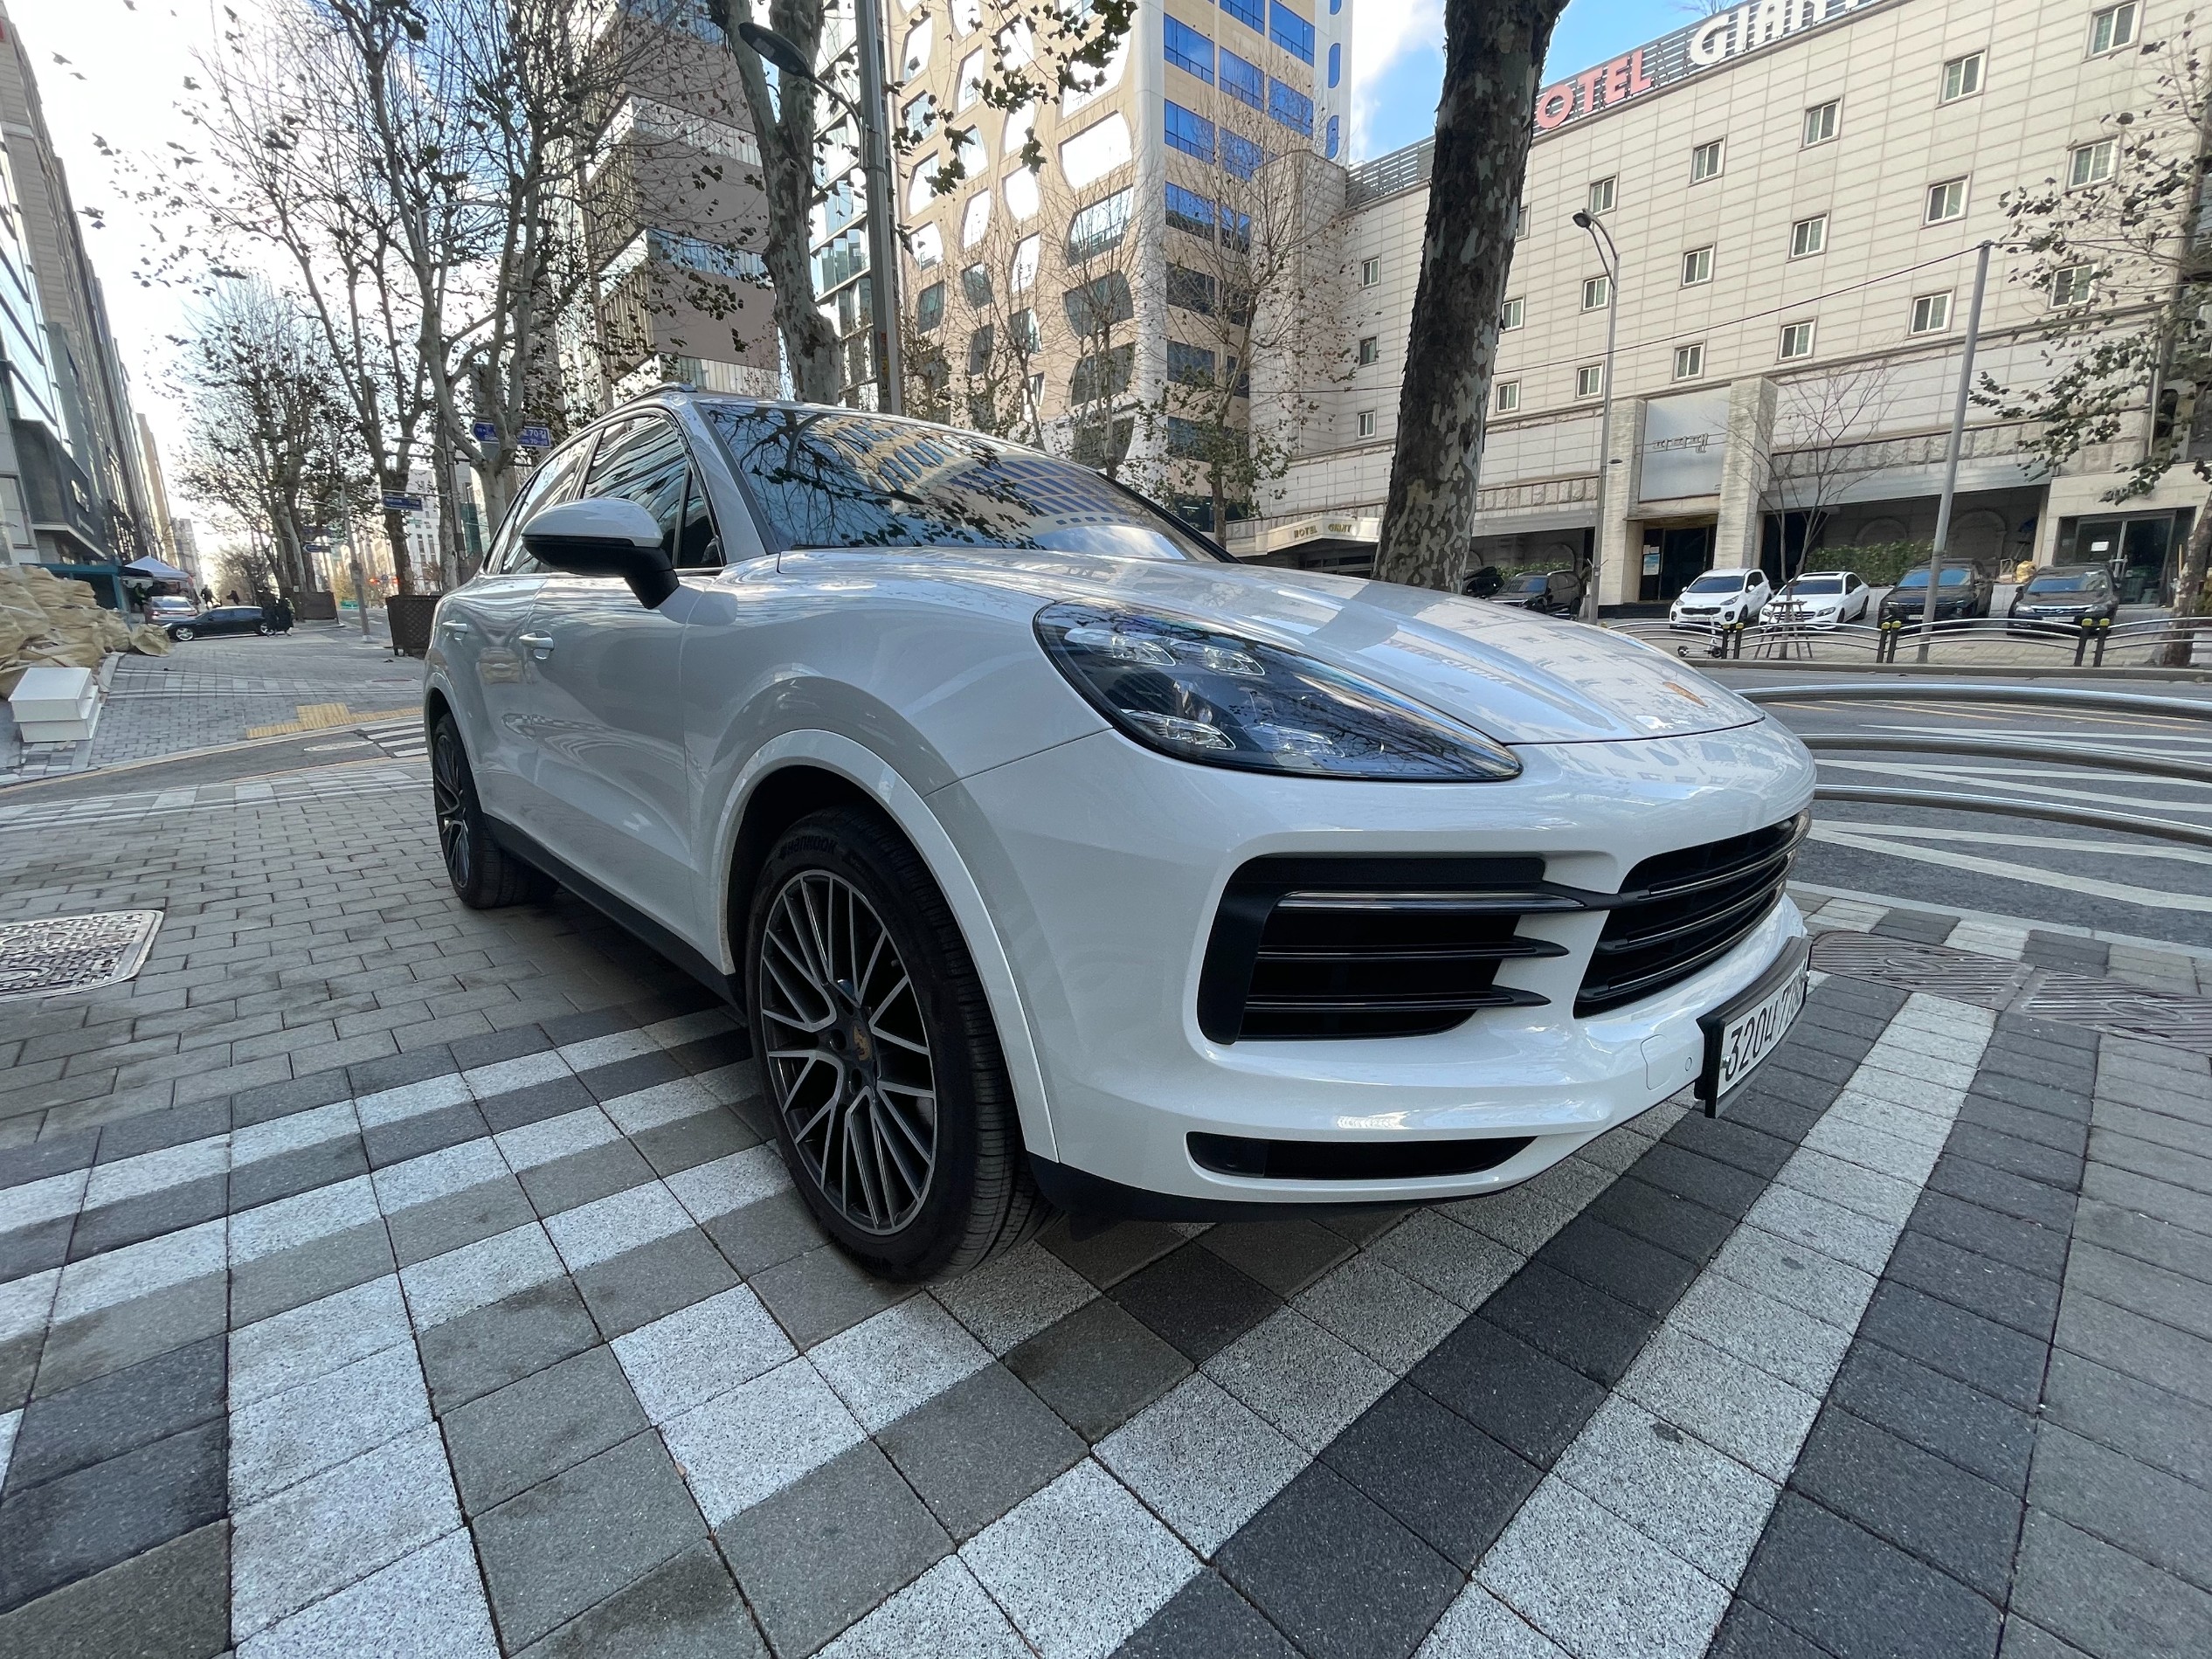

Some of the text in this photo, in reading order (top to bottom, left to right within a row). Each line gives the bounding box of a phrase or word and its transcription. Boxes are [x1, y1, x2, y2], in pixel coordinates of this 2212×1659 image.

[1535, 0, 1860, 129] OTEL GIAN
[1294, 525, 1317, 538] HOTEL
